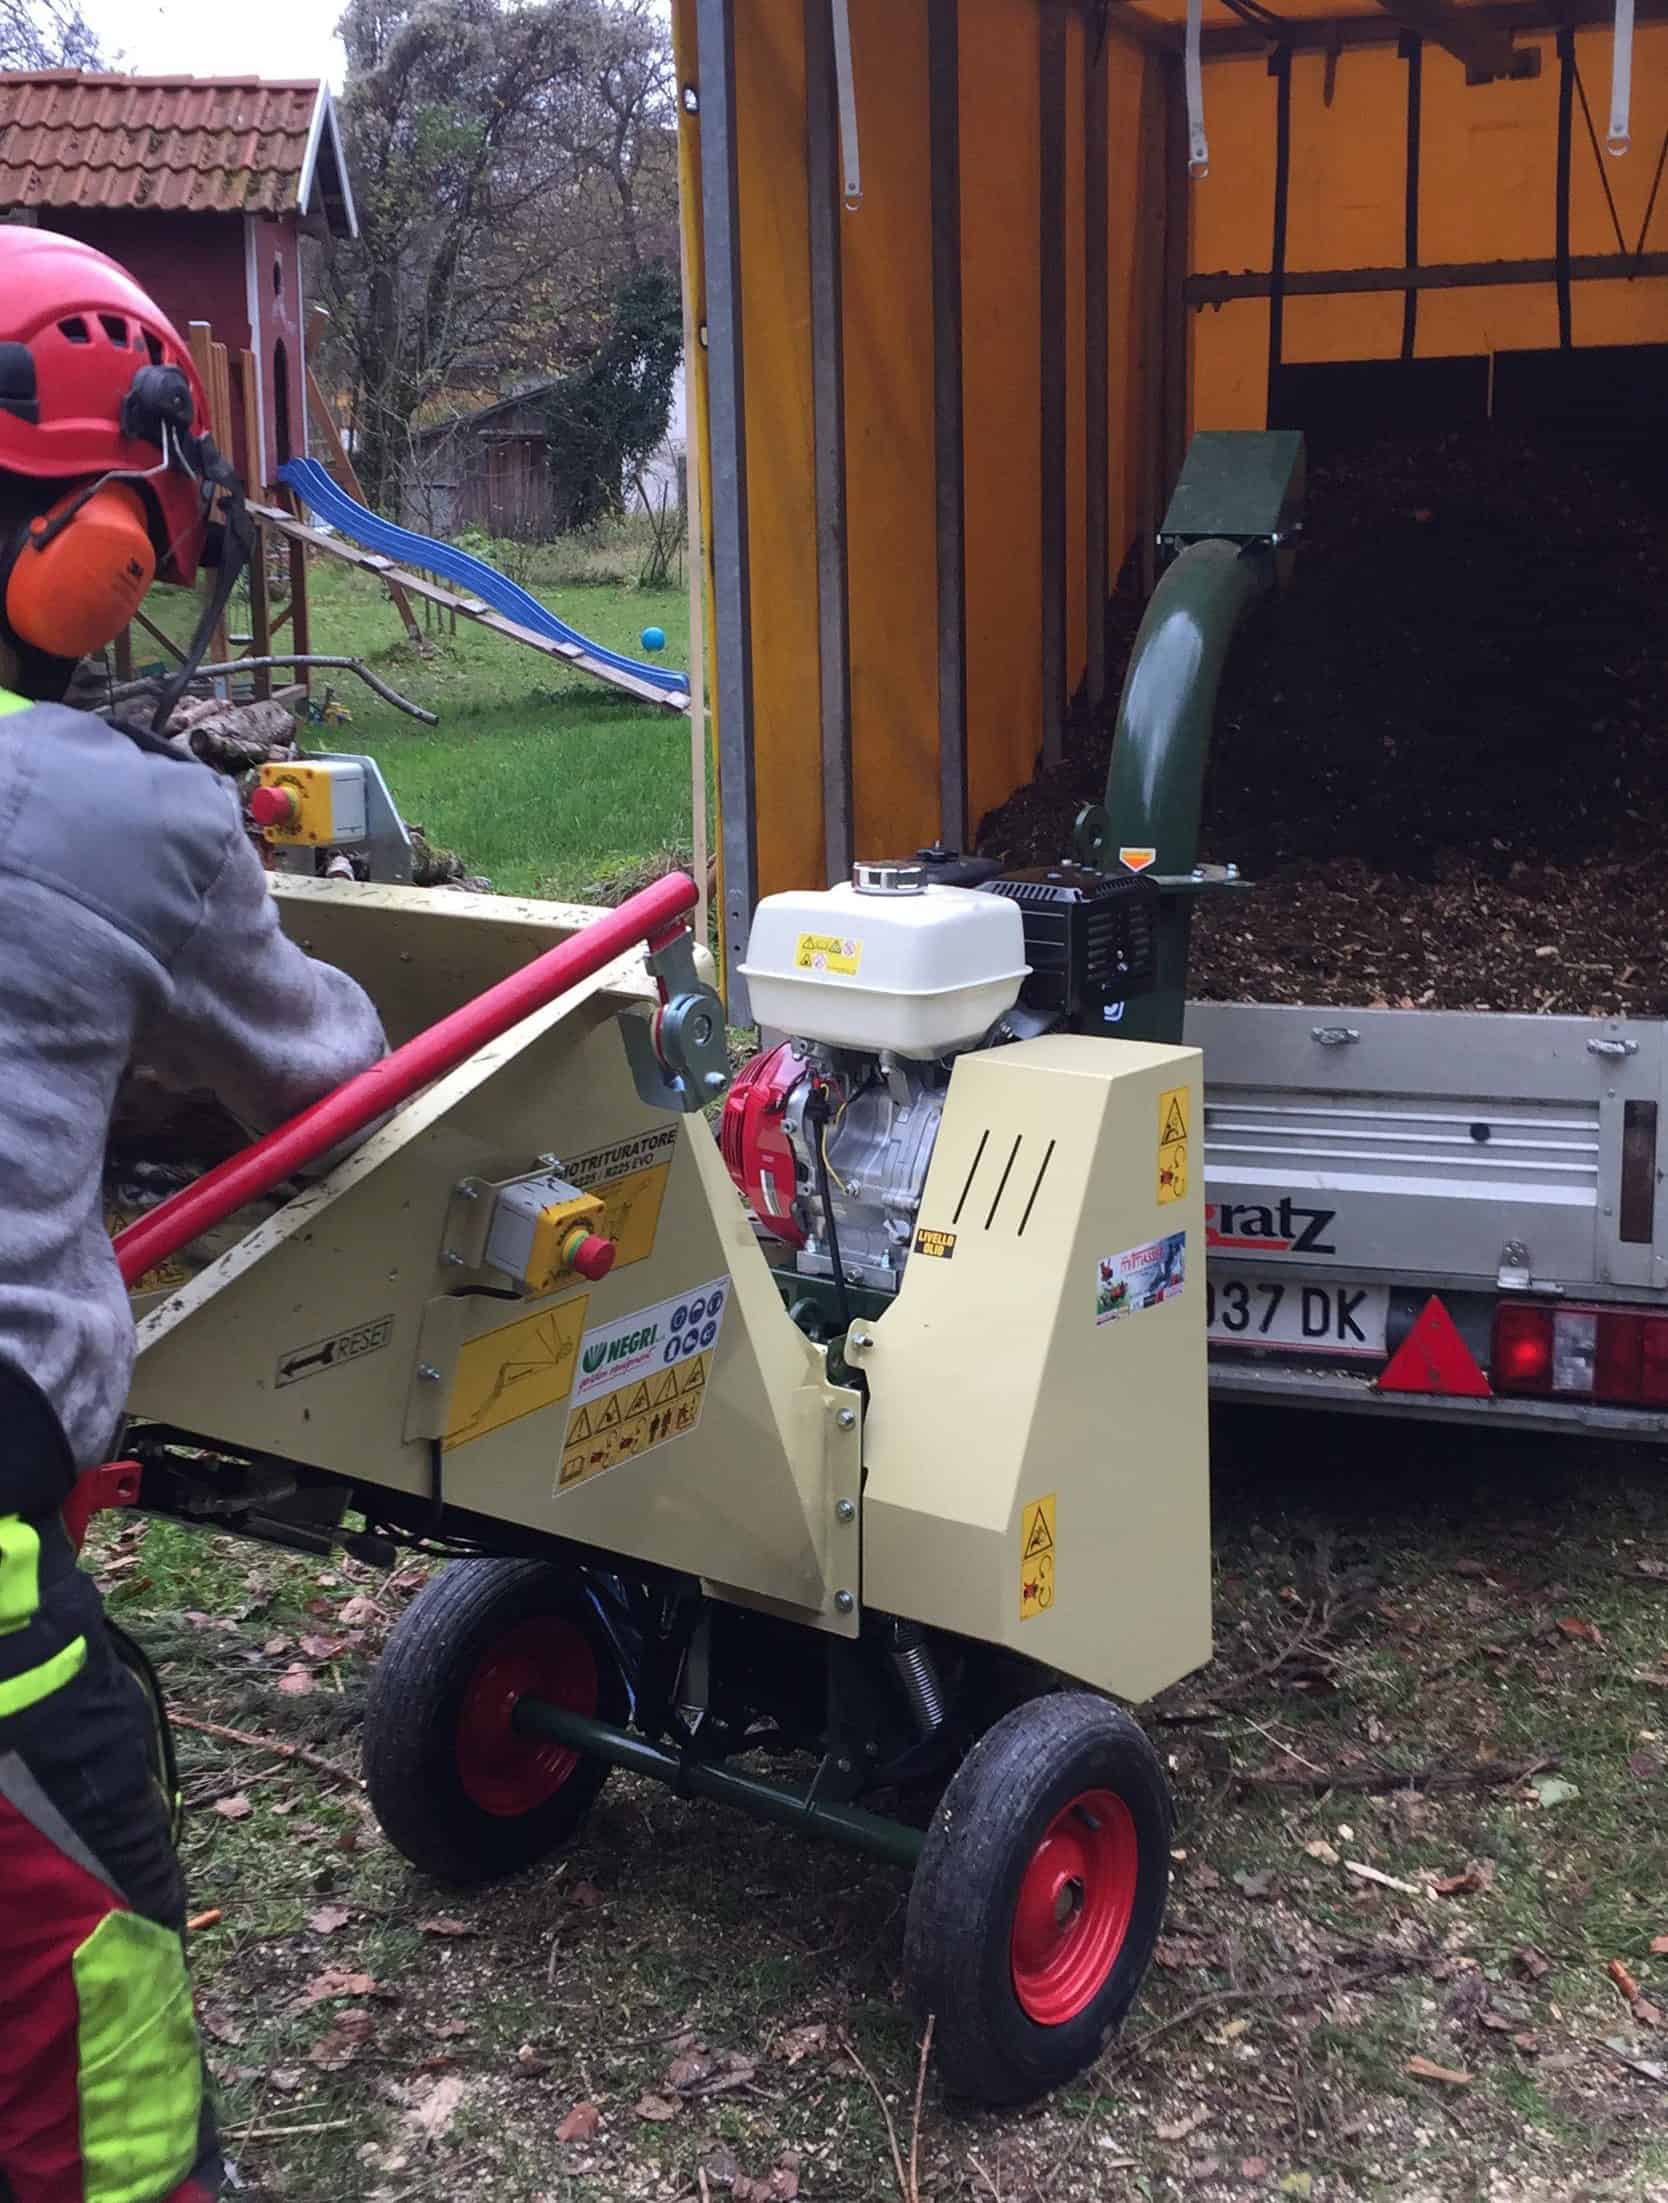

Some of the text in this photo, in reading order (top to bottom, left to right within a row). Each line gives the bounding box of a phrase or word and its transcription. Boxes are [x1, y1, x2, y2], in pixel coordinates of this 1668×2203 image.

[918, 1230, 954, 1247] LIVELLO
[1302, 1286, 1368, 1343] DK
[339, 1321, 392, 1357] RESET
[607, 1323, 658, 1362] NEGRI
